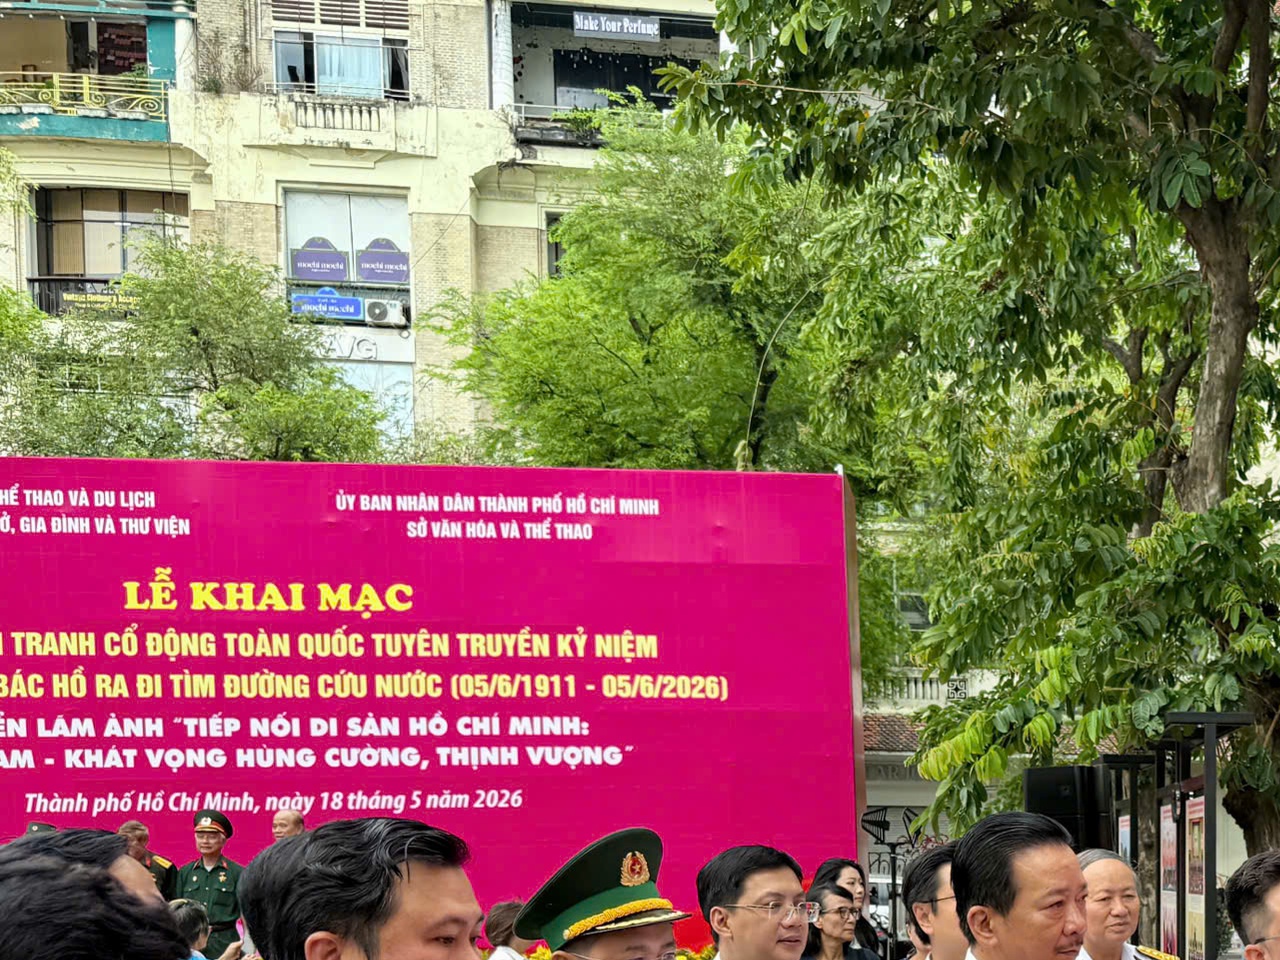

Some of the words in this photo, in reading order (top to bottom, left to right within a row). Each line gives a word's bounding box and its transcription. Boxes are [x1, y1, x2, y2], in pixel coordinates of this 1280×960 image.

[575, 14, 599, 31] Make
[600, 16, 621, 33] Your
[623, 18, 659, 36] Perfume
[297, 261, 320, 269] mochi
[321, 262, 344, 270] mochi
[384, 263, 408, 271] mochi
[24, 490, 63, 507] THAO
[68, 487, 89, 507] VÀ
[94, 491, 115, 507] DU
[121, 491, 155, 511] LỊCH
[336, 489, 359, 511] ỦY
[361, 495, 391, 511] BAN
[396, 493, 438, 511] NHÂN
[443, 493, 474, 512] DÂN
[478, 494, 528, 513] THÀNH
[532, 492, 562, 513] PHỐ
[566, 492, 586, 513] HỒ
[590, 494, 615, 514] CHÍ
[619, 499, 659, 515] MINH
[20, 516, 47, 533] GIA
[51, 513, 90, 534] ĐÌNH
[95, 514, 115, 534] VÀ
[120, 516, 151, 534] THƯ
[154, 515, 190, 538] VIỆN
[407, 518, 428, 538] SỞ
[432, 520, 462, 538] VĂN
[466, 520, 497, 538] HÓA
[500, 521, 521, 539] VÀ
[524, 518, 552, 539] THỂ
[555, 523, 593, 539] THAO
[123, 567, 178, 610] LỄ
[190, 583, 306, 611] KHAI
[317, 583, 413, 619] MẠC
[11, 631, 96, 656] TRANH
[104, 623, 139, 657] CỔ
[146, 628, 216, 661] ĐỘNG
[223, 628, 290, 657] TOÀN
[298, 625, 365, 659] QUỐC
[372, 628, 449, 658] TUYÊN
[457, 626, 550, 658] TRUYỀN
[557, 626, 587, 658] KỶ
[595, 630, 658, 662] NIỆM
[53, 665, 86, 698] HỒ
[96, 674, 129, 698] RA
[136, 674, 162, 698] ĐI
[170, 669, 215, 698] TÌM
[223, 669, 310, 698] ĐƯỜNG
[318, 669, 367, 698] CỨU
[375, 669, 442, 698] NƯỚC
[451, 674, 576, 700] (05/6/1911
[602, 675, 729, 702] 05/6/2026)
[103, 712, 164, 738] ẢNH
[249, 712, 302, 738] NỐI
[310, 718, 338, 737] DI
[409, 710, 447, 736] HỒ
[456, 712, 500, 736] CHÍ
[509, 717, 590, 736] MINH:
[65, 746, 138, 768] KHÁT
[147, 749, 227, 773] VỌNG
[236, 747, 316, 768] HÙNG
[324, 747, 429, 770] CƯỜNG,
[436, 747, 519, 770] THỊNH
[25, 792, 91, 813] Thành
[93, 790, 136, 817] phố
[137, 791, 164, 812] Hồ
[168, 791, 201, 812] Chí
[203, 792, 261, 813] Minh,
[265, 792, 315, 817] ngày
[319, 793, 344, 811] 18
[347, 791, 405, 814] tháng
[410, 791, 421, 809] 5
[425, 792, 469, 809] năm
[473, 789, 523, 808] 2026
